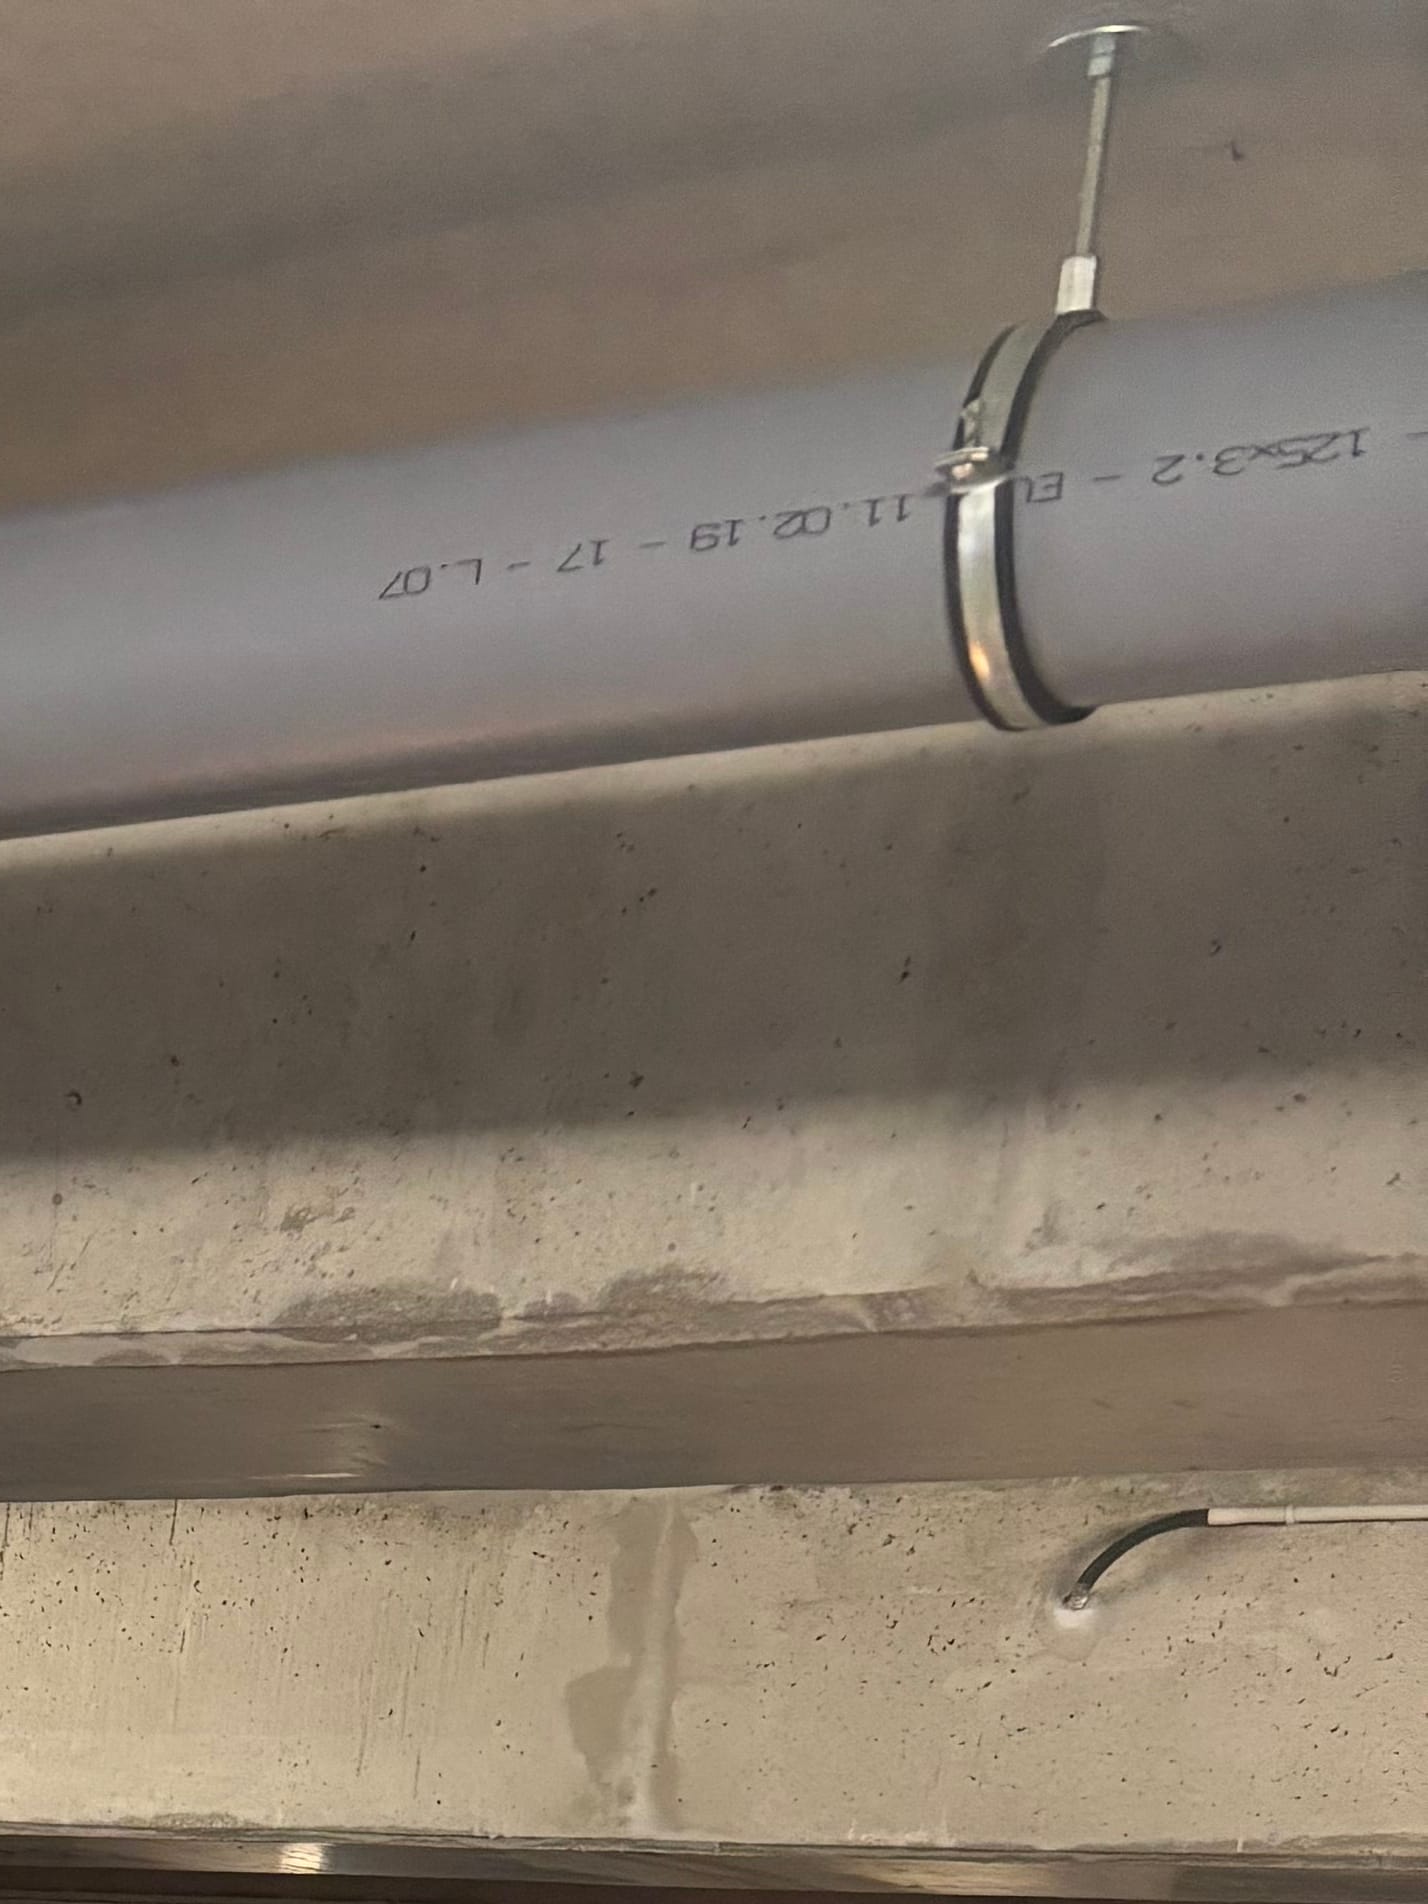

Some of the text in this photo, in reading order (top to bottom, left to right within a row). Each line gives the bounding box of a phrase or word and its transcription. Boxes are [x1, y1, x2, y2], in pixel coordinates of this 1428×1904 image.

[1151, 426, 1371, 486] 125x3.2
[689, 494, 913, 553] 11.02.19
[378, 557, 483, 600] L.07
[556, 537, 611, 574] 17
